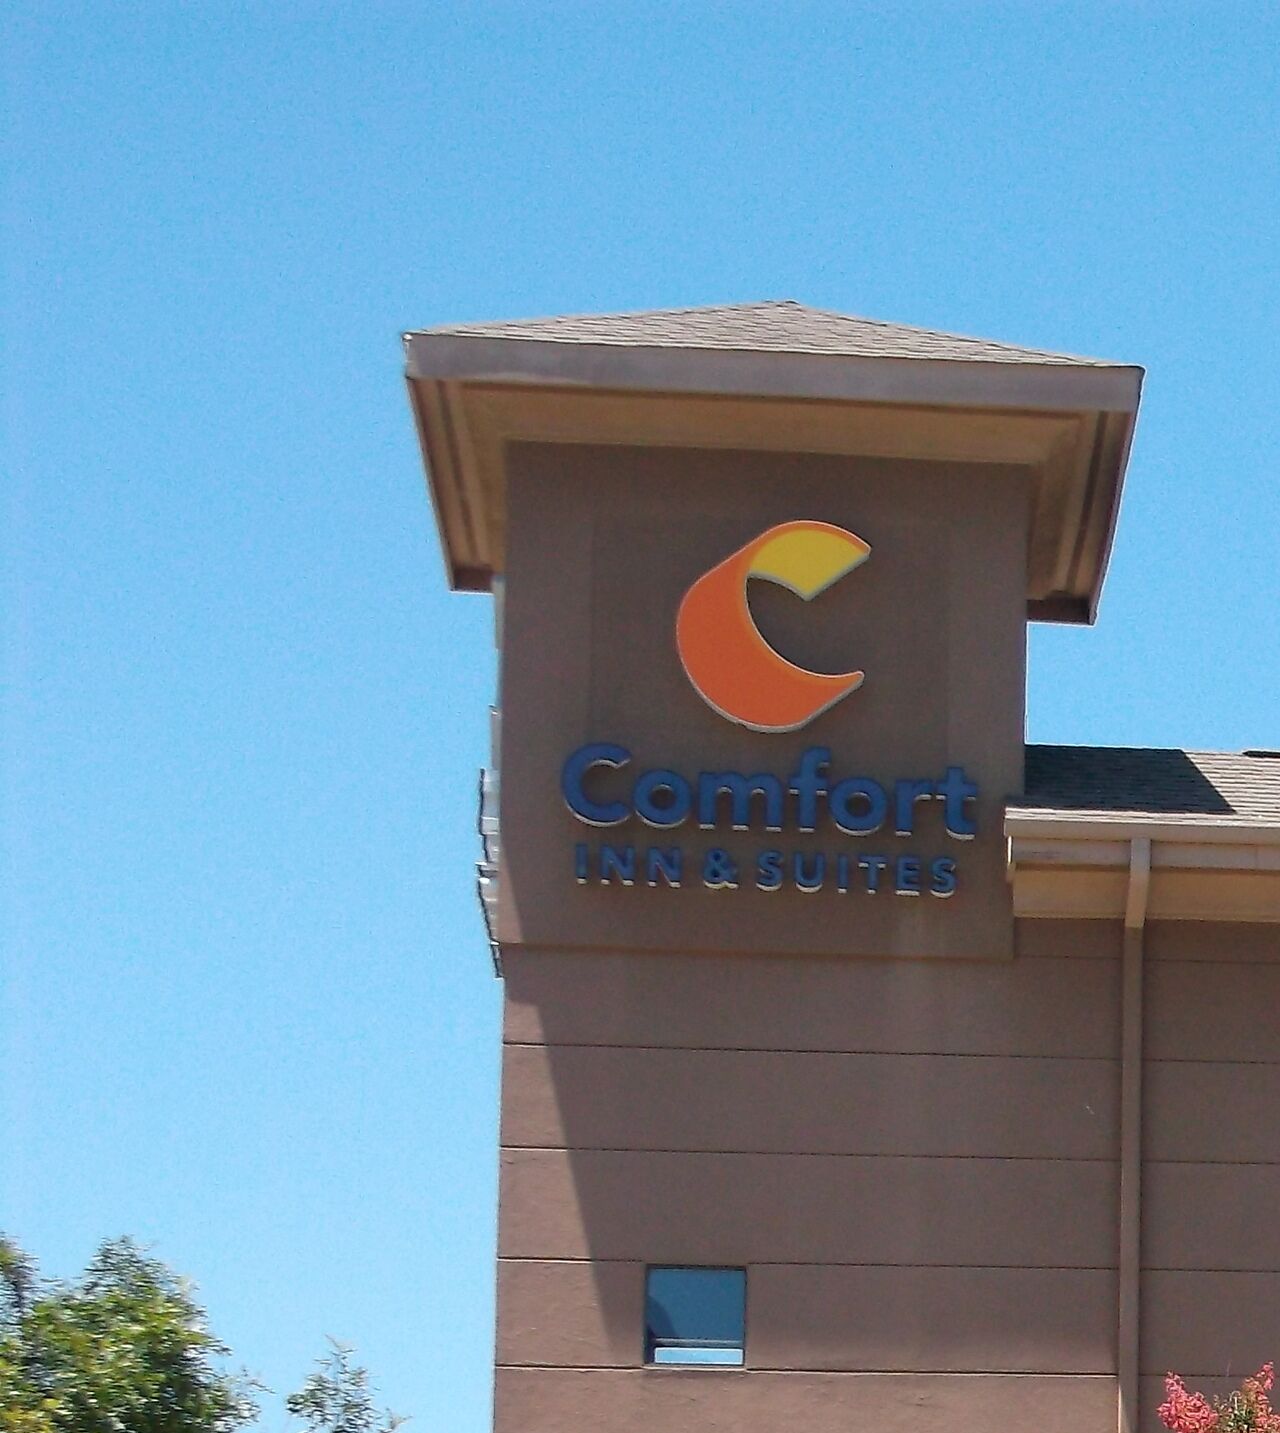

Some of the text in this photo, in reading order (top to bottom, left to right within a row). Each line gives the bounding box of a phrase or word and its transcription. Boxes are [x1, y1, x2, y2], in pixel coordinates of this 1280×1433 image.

[561, 742, 978, 840] Comfort
[574, 843, 957, 898] INN & SUITES
